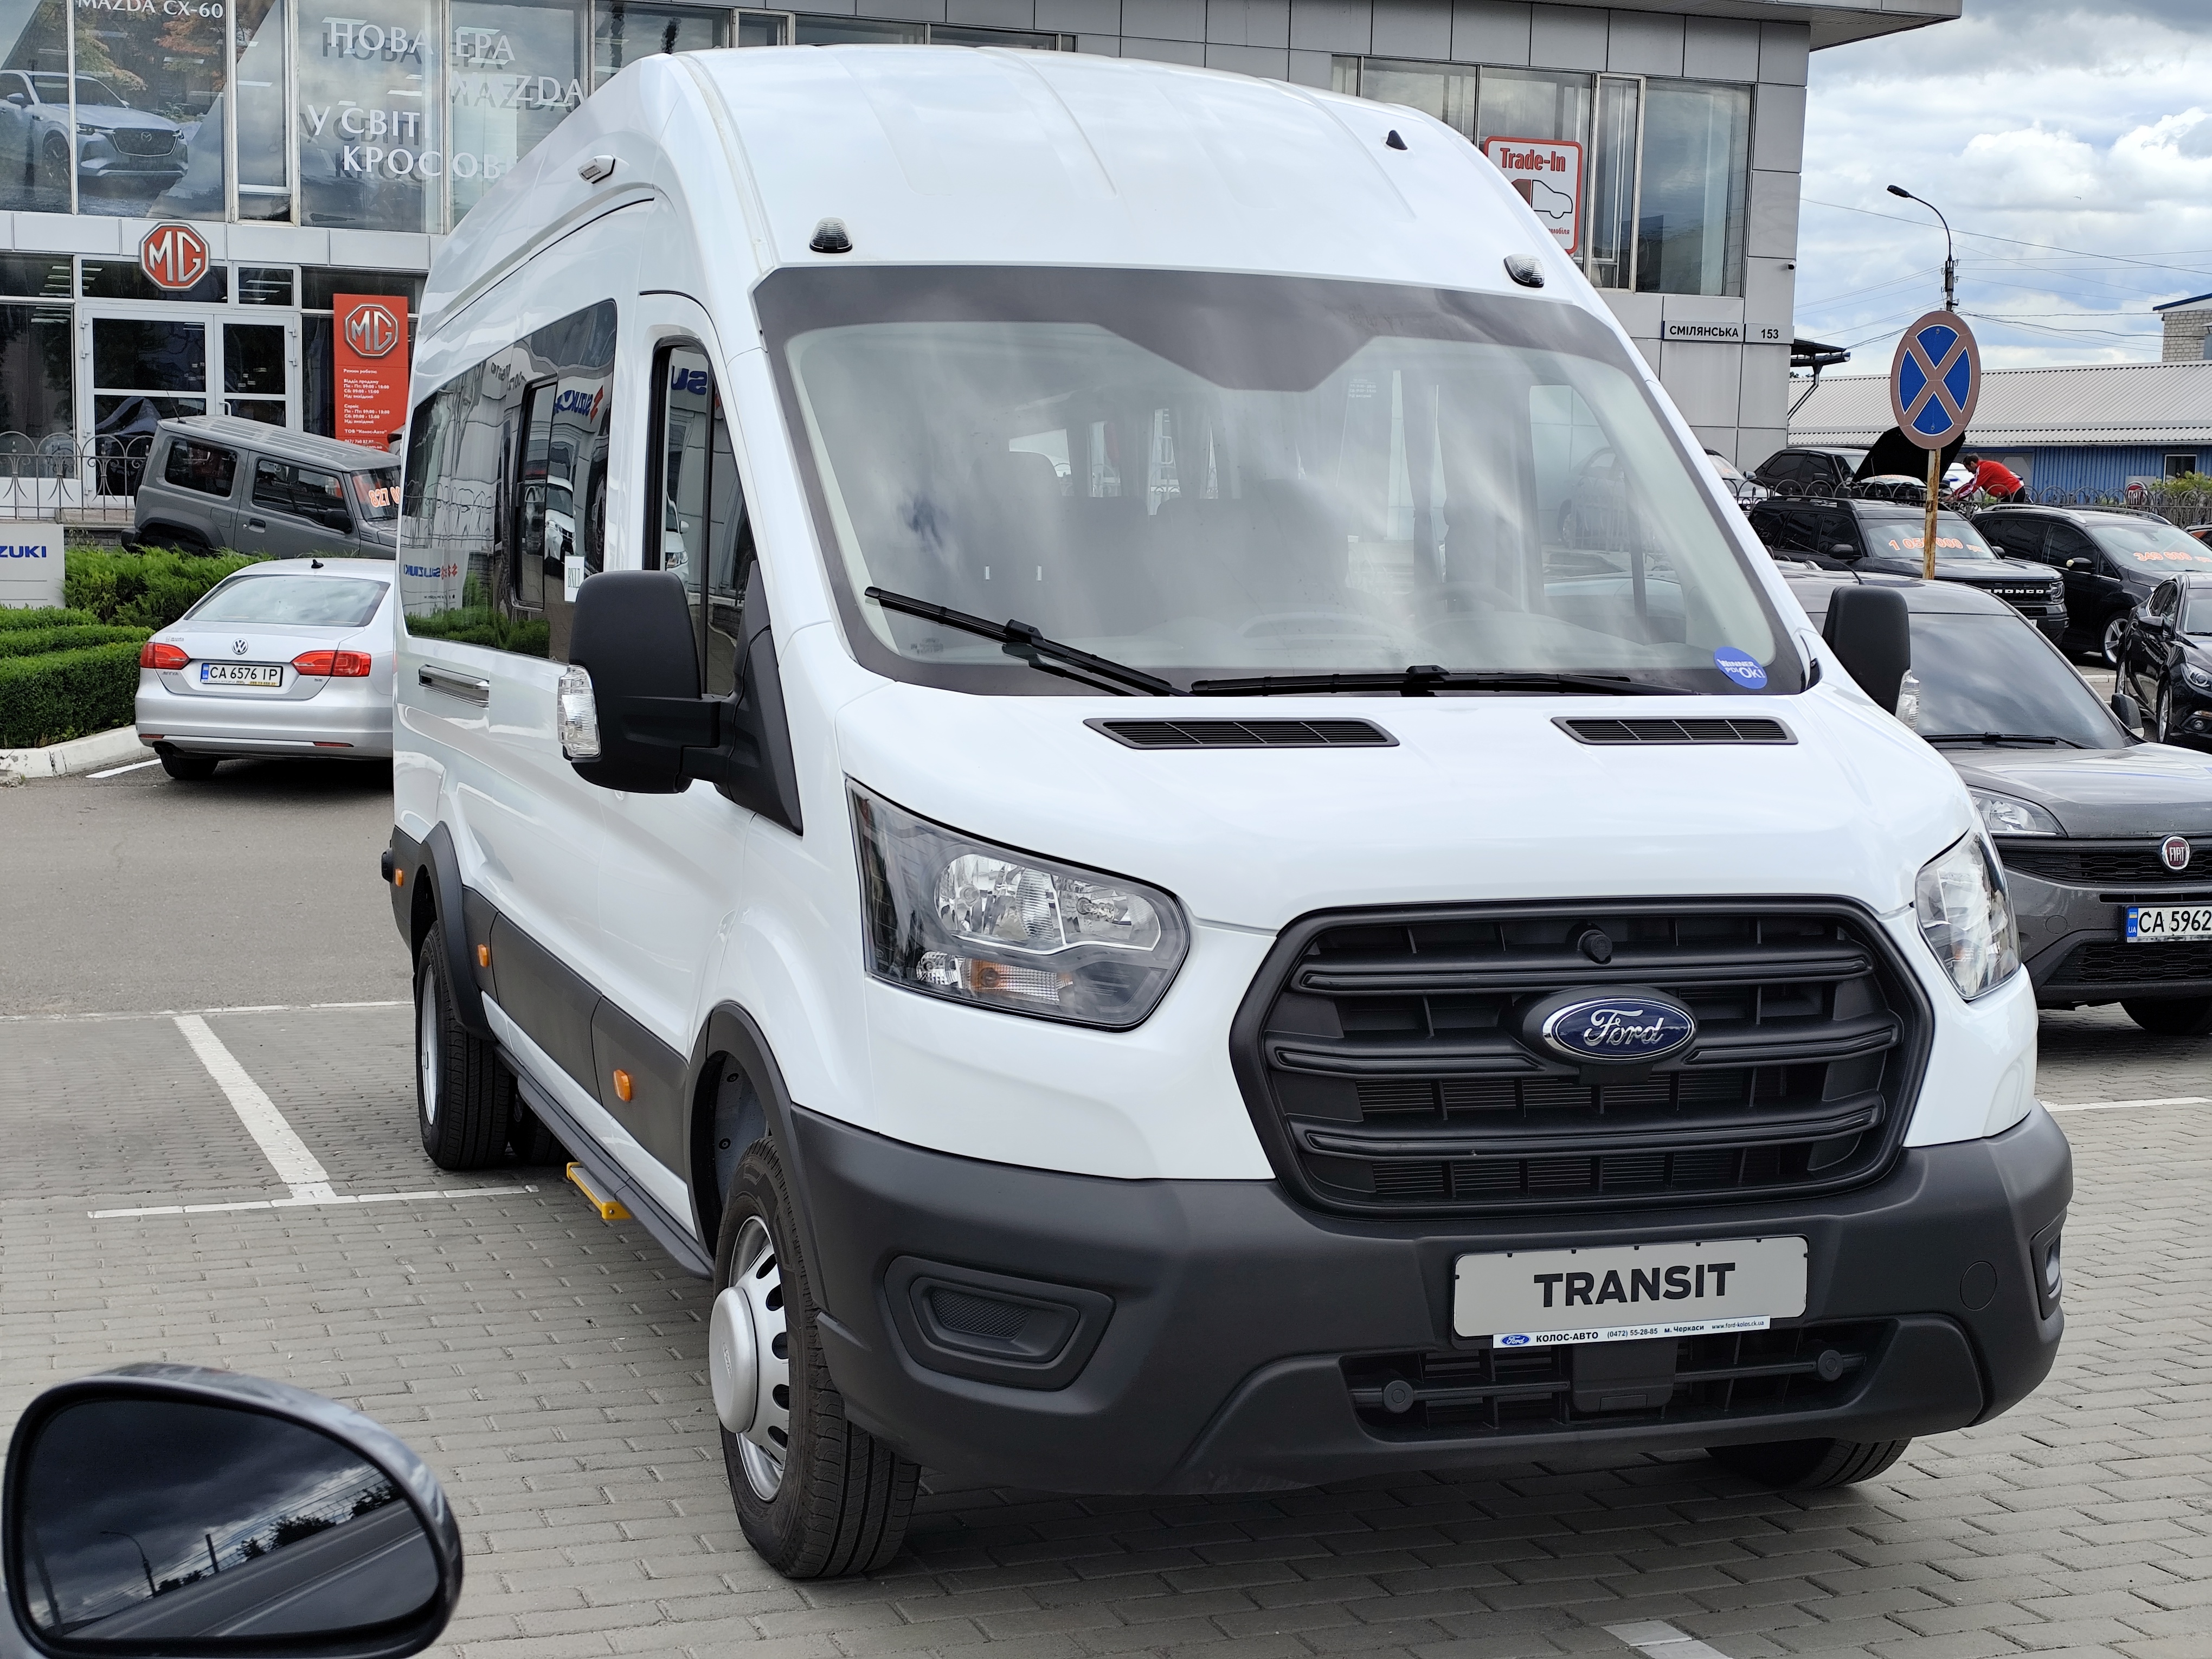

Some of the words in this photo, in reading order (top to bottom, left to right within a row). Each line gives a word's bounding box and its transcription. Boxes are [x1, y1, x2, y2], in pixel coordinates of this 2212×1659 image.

[164, 0, 223, 18] CX-60
[452, 70, 584, 106] MAZDA
[307, 105, 331, 136] У
[1500, 147, 1566, 172] Trade-In
[149, 230, 202, 281] MG
[351, 310, 392, 351] MG
[1669, 325, 1739, 337] СМІЛЯНСЬКА
[1761, 329, 1779, 339] 153
[369, 488, 390, 507] 827
[1888, 538, 1900, 551] 1
[1902, 537, 1925, 550] 05
[210, 667, 227, 679] CA
[230, 667, 257, 680] 6576
[2169, 846, 2185, 861] FIAT
[2139, 911, 2164, 933] CA
[2170, 909, 2212, 932] 5962
[1584, 1008, 1664, 1046] Ford
[1534, 1262, 1735, 1307] TRANSIT
[1506, 1335, 1526, 1345] Ford
[1536, 1332, 1599, 1342] КОЛОС-АВТО
[1607, 1329, 1628, 1339] (0472)
[1630, 1328, 1658, 1336] 55-28-85
[1673, 1324, 1705, 1333] Черкаси
[1712, 1320, 1764, 1329] www.ford-kolos.ck.ua
